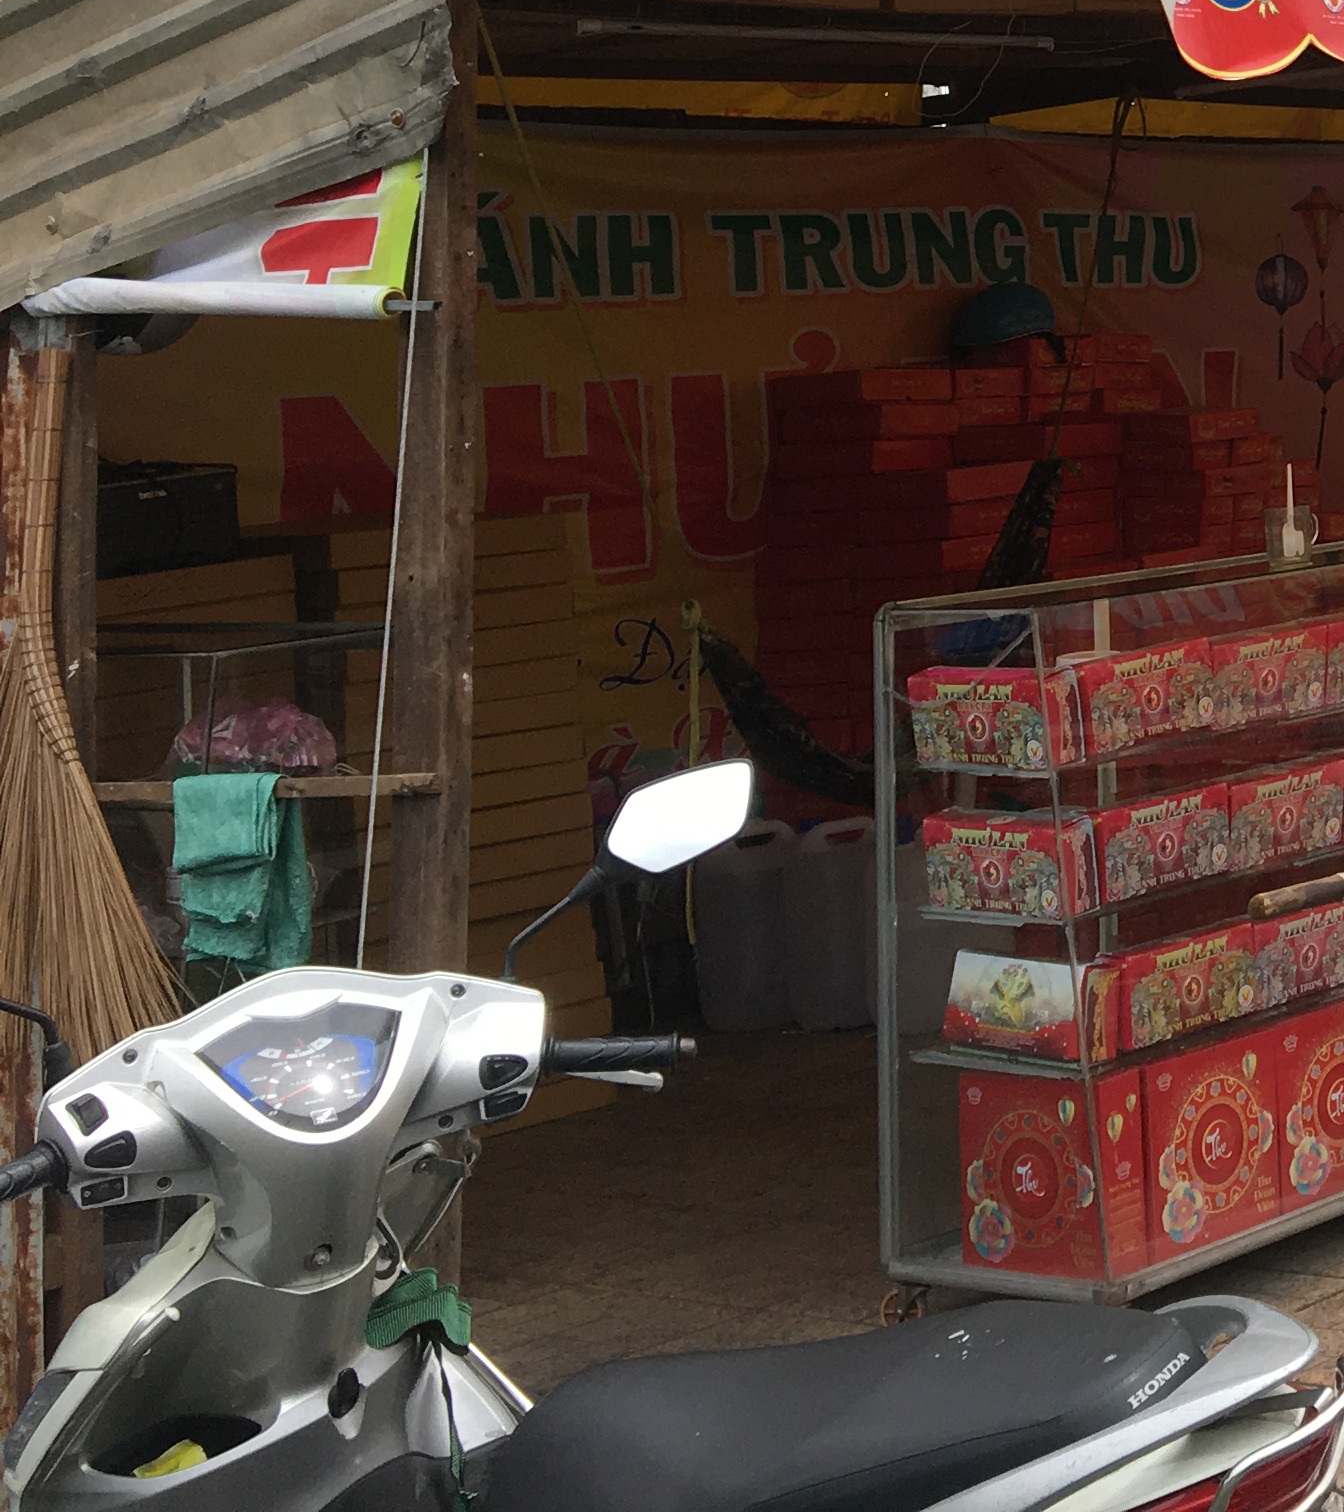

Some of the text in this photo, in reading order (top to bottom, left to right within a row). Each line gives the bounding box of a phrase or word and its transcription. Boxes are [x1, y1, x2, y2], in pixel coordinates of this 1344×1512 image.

[478, 191, 683, 302] ÁNH
[706, 209, 1028, 291] TRUNG
[1040, 209, 1202, 289] THU
[1127, 1350, 1191, 1410] HONDA
